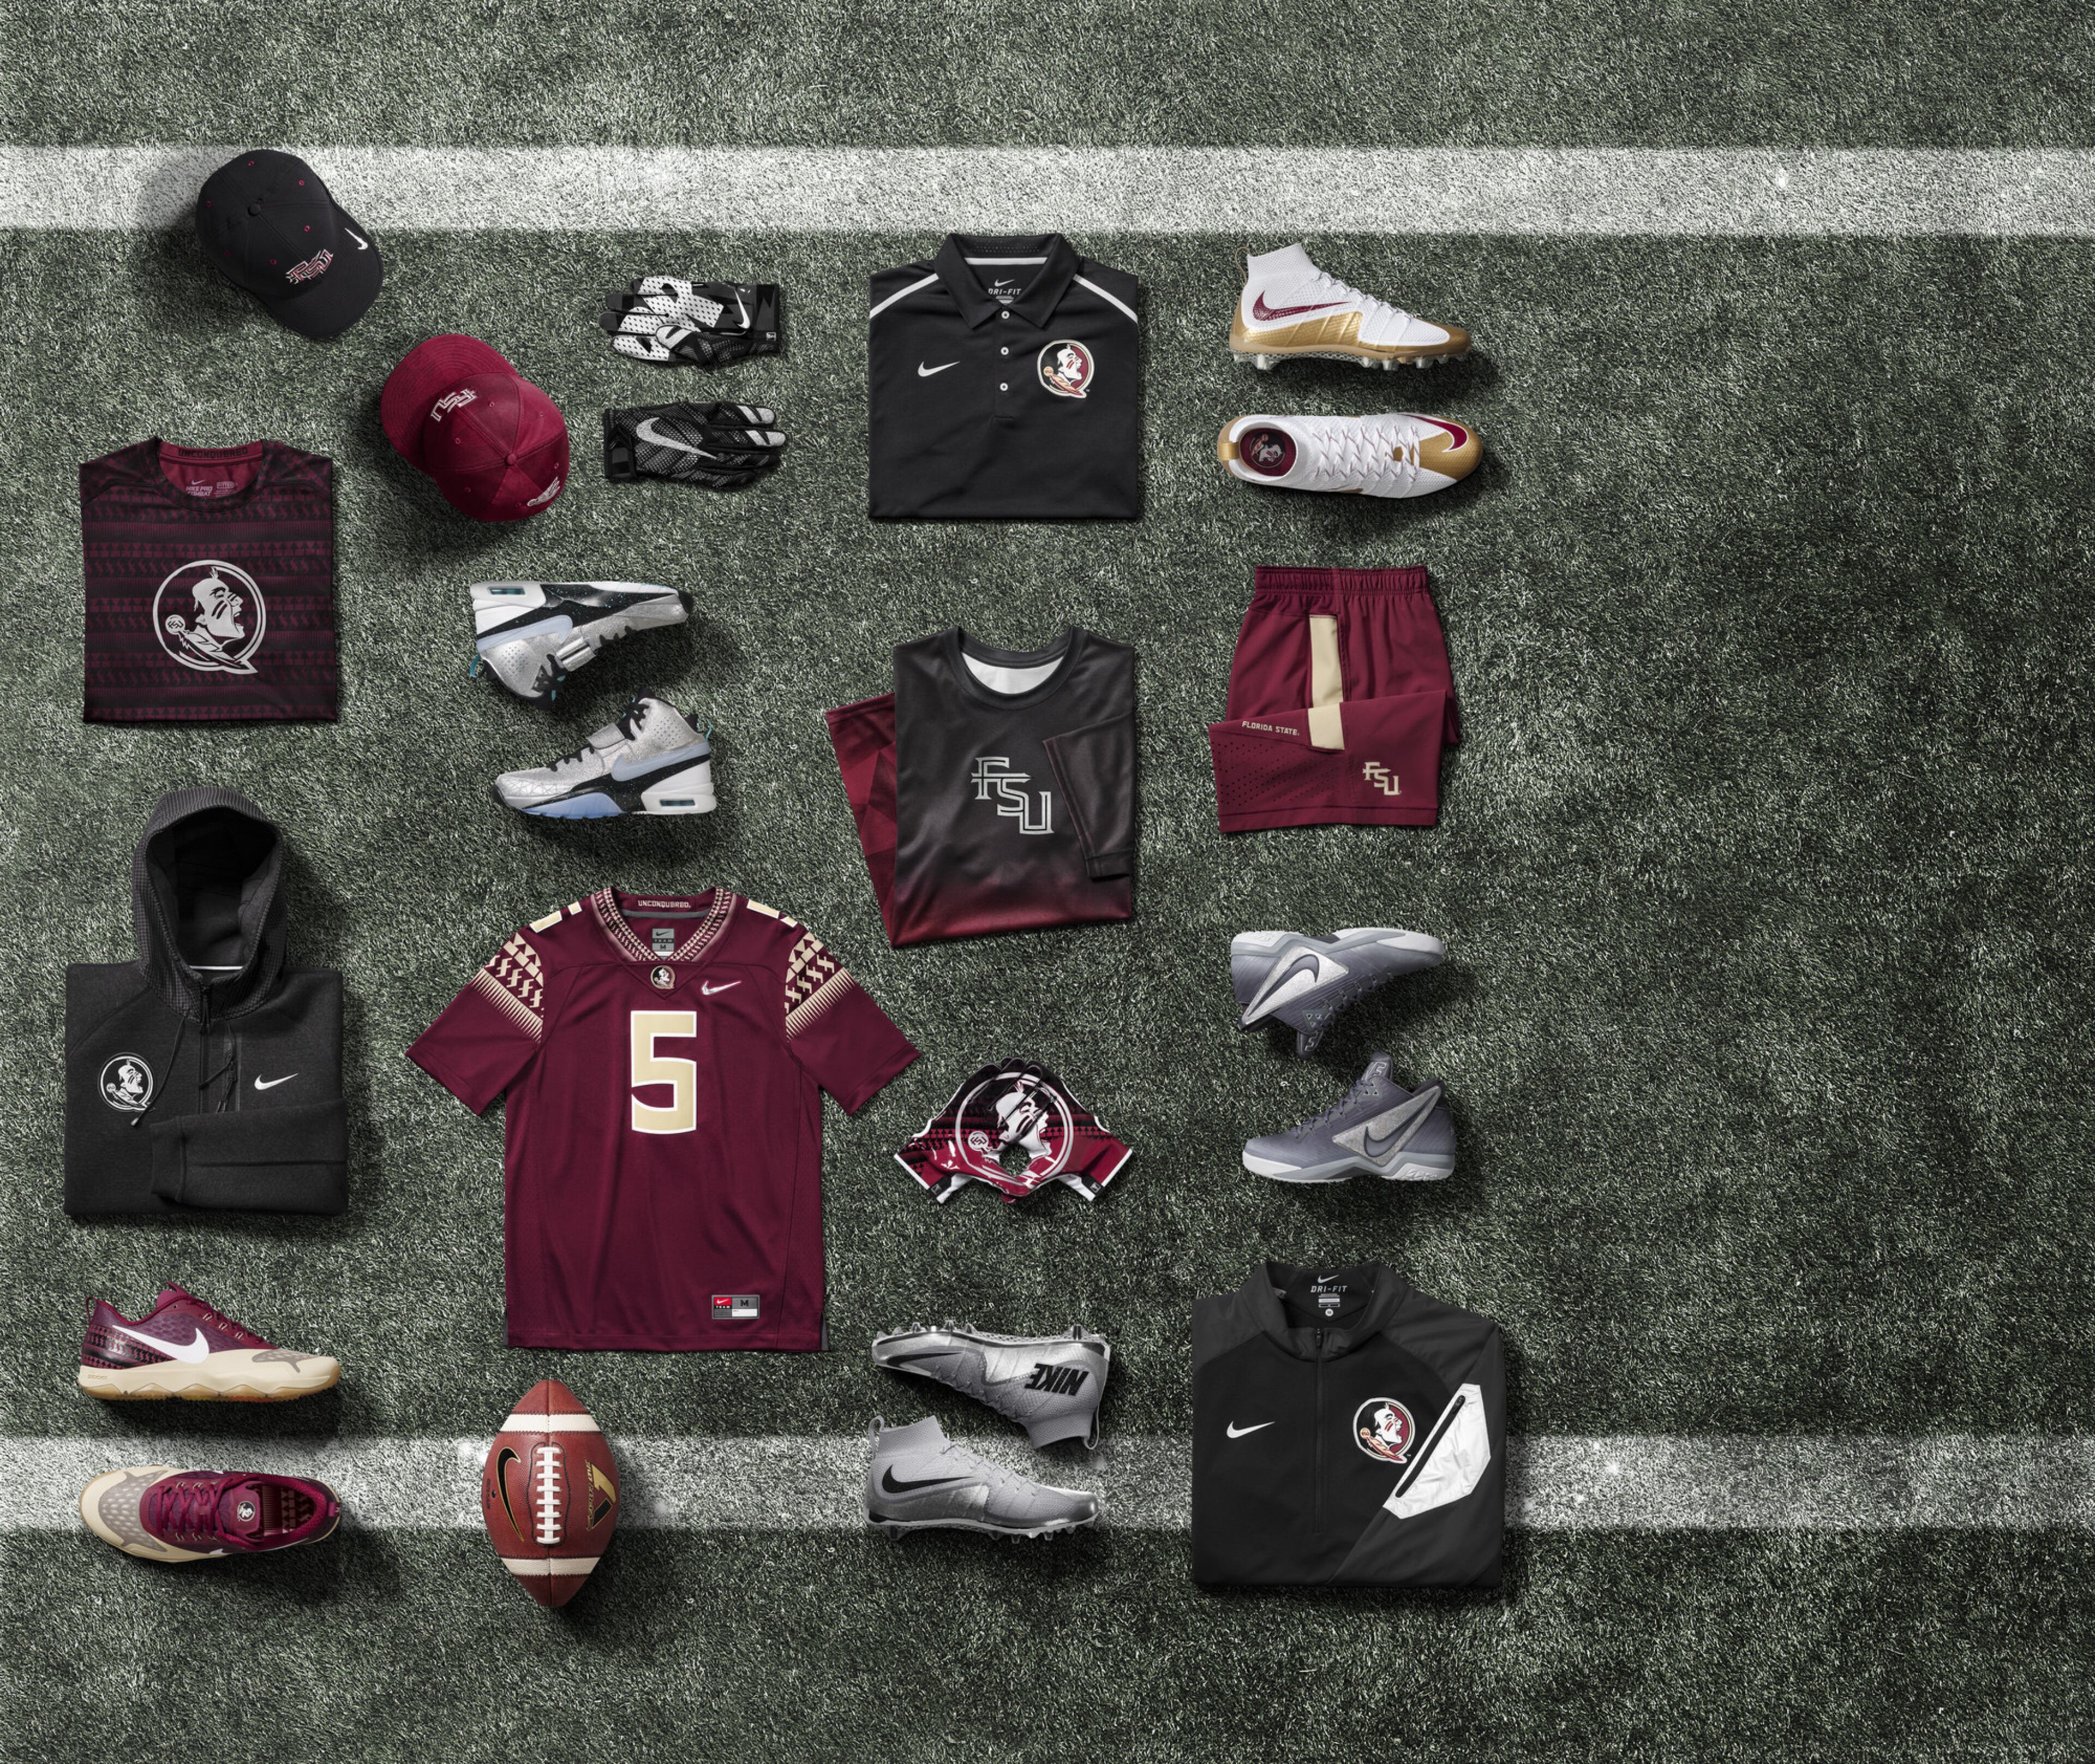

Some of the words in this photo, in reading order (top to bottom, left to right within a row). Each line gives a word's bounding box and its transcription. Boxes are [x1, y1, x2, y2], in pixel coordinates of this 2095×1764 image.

[1242, 721, 1273, 731] FLORIDA
[1362, 762, 1400, 795] FSU
[971, 756, 1055, 835] FSU
[630, 1010, 697, 1134] 5
[1024, 1363, 1090, 1396] NIKE
